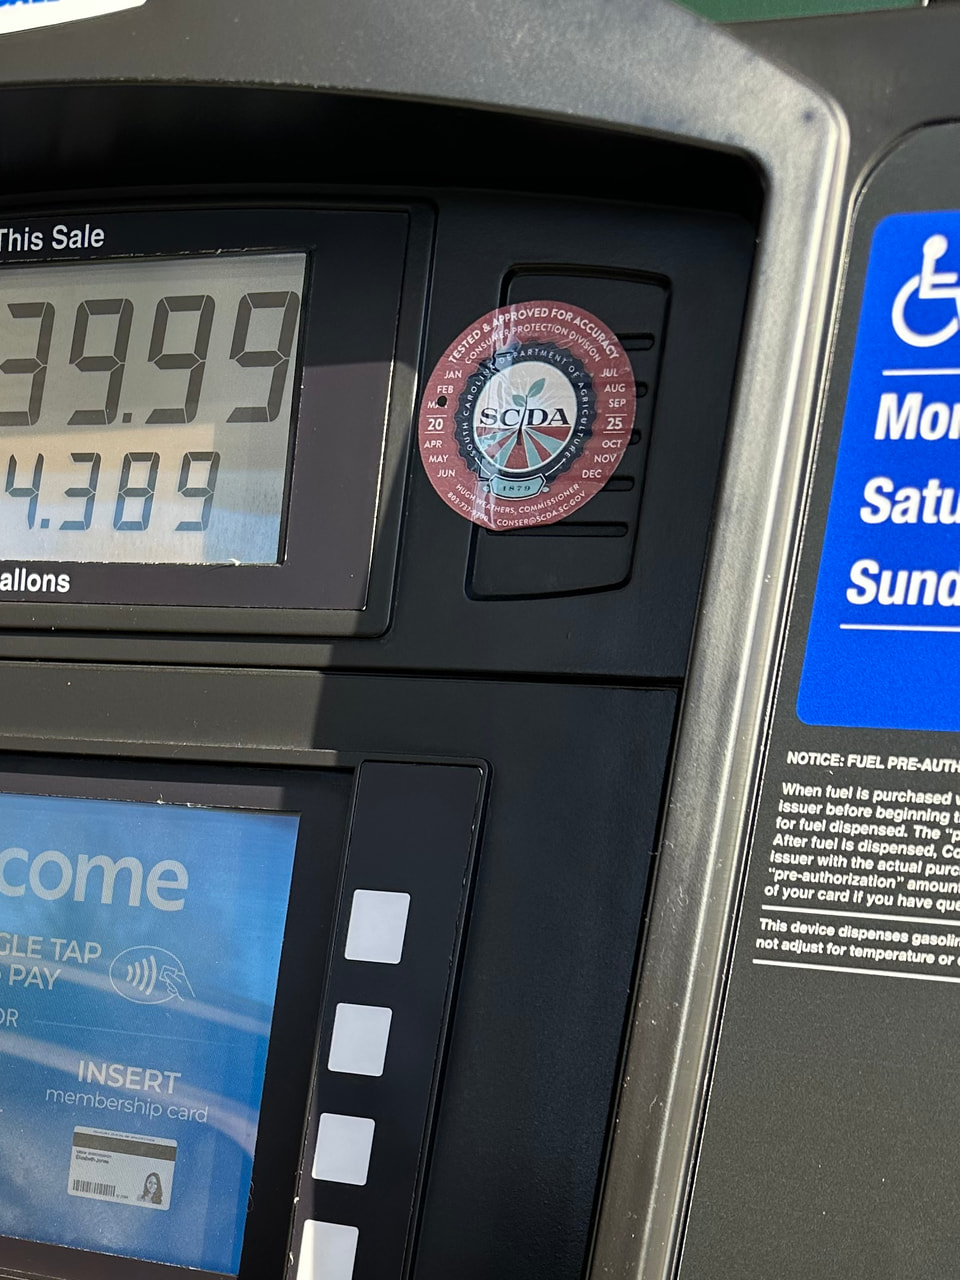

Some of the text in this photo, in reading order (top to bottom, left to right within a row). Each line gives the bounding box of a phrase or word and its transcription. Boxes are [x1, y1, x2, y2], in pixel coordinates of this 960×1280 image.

[51, 223, 104, 249] Sale
[449, 307, 620, 364] TESTED & APPROVED FOR ACCURACY
[443, 370, 462, 379] JAN
[600, 368, 619, 378] JUL
[604, 384, 627, 394] AUG
[608, 398, 627, 409] SEP
[428, 418, 444, 431] 20
[478, 407, 571, 427] SCDA
[606, 417, 623, 430] 25
[601, 439, 623, 449] OCT
[594, 454, 618, 464] NOV
[582, 469, 603, 479] DEC
[786, 750, 844, 766] NOTICE:
[846, 753, 884, 769] FUEL
[782, 781, 952, 805] When fuel is purchased
[50, 938, 101, 963] TAP
[8, 963, 62, 989] PAY
[78, 1060, 181, 1094] INSERT
[45, 1088, 208, 1122] membership card
